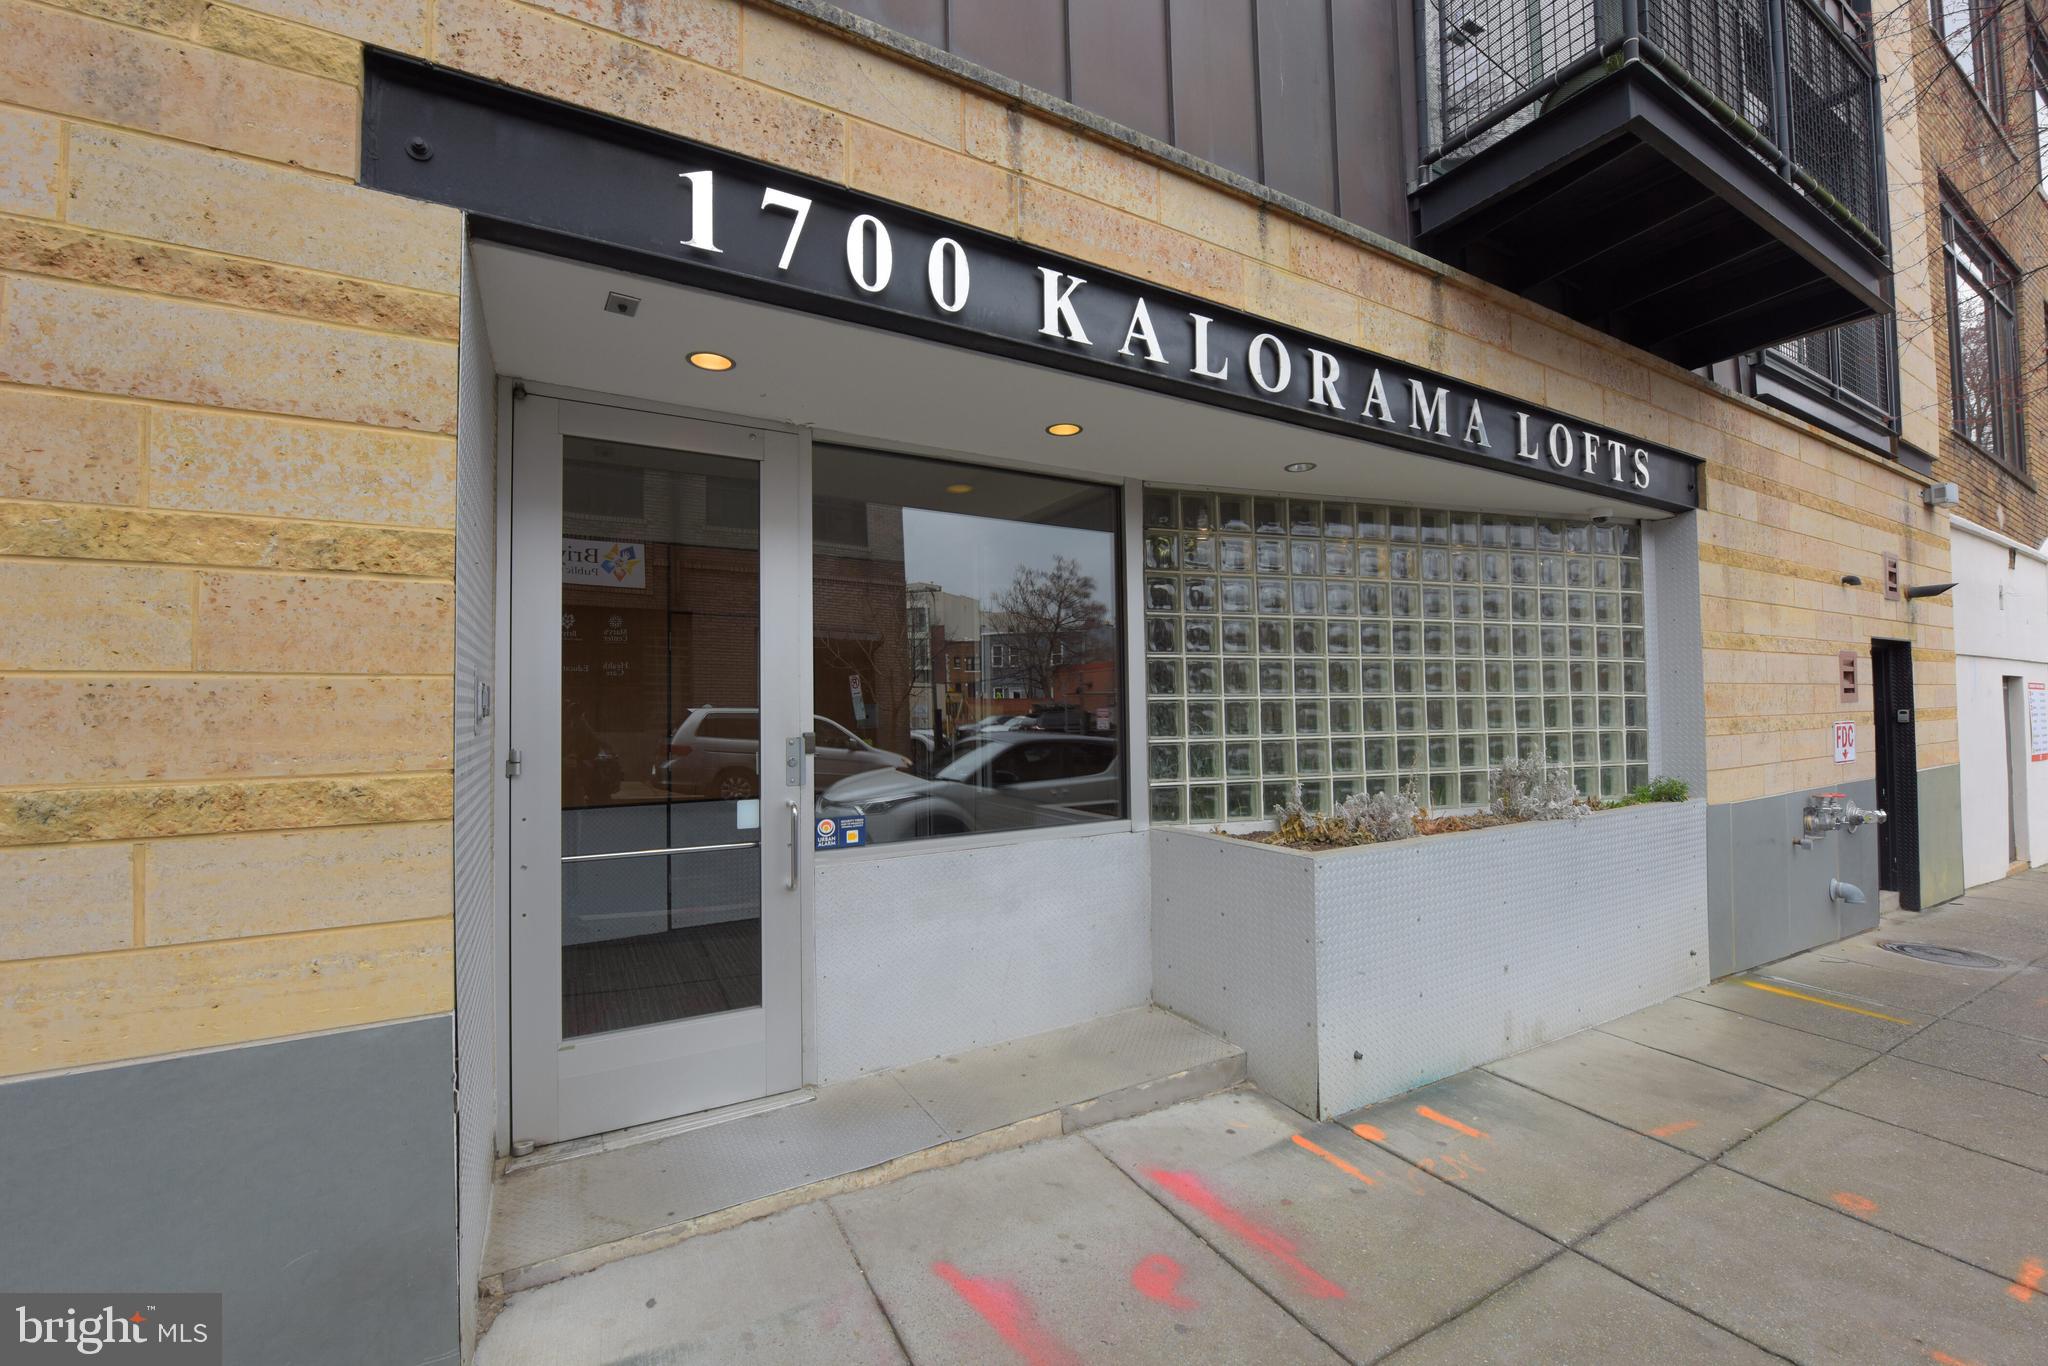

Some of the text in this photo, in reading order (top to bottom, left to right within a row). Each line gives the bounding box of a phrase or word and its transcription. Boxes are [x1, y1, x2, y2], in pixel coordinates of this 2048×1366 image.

[679, 171, 1650, 489] 1700 KALORAMA LOFTS
[1836, 725, 1854, 748] FDC
